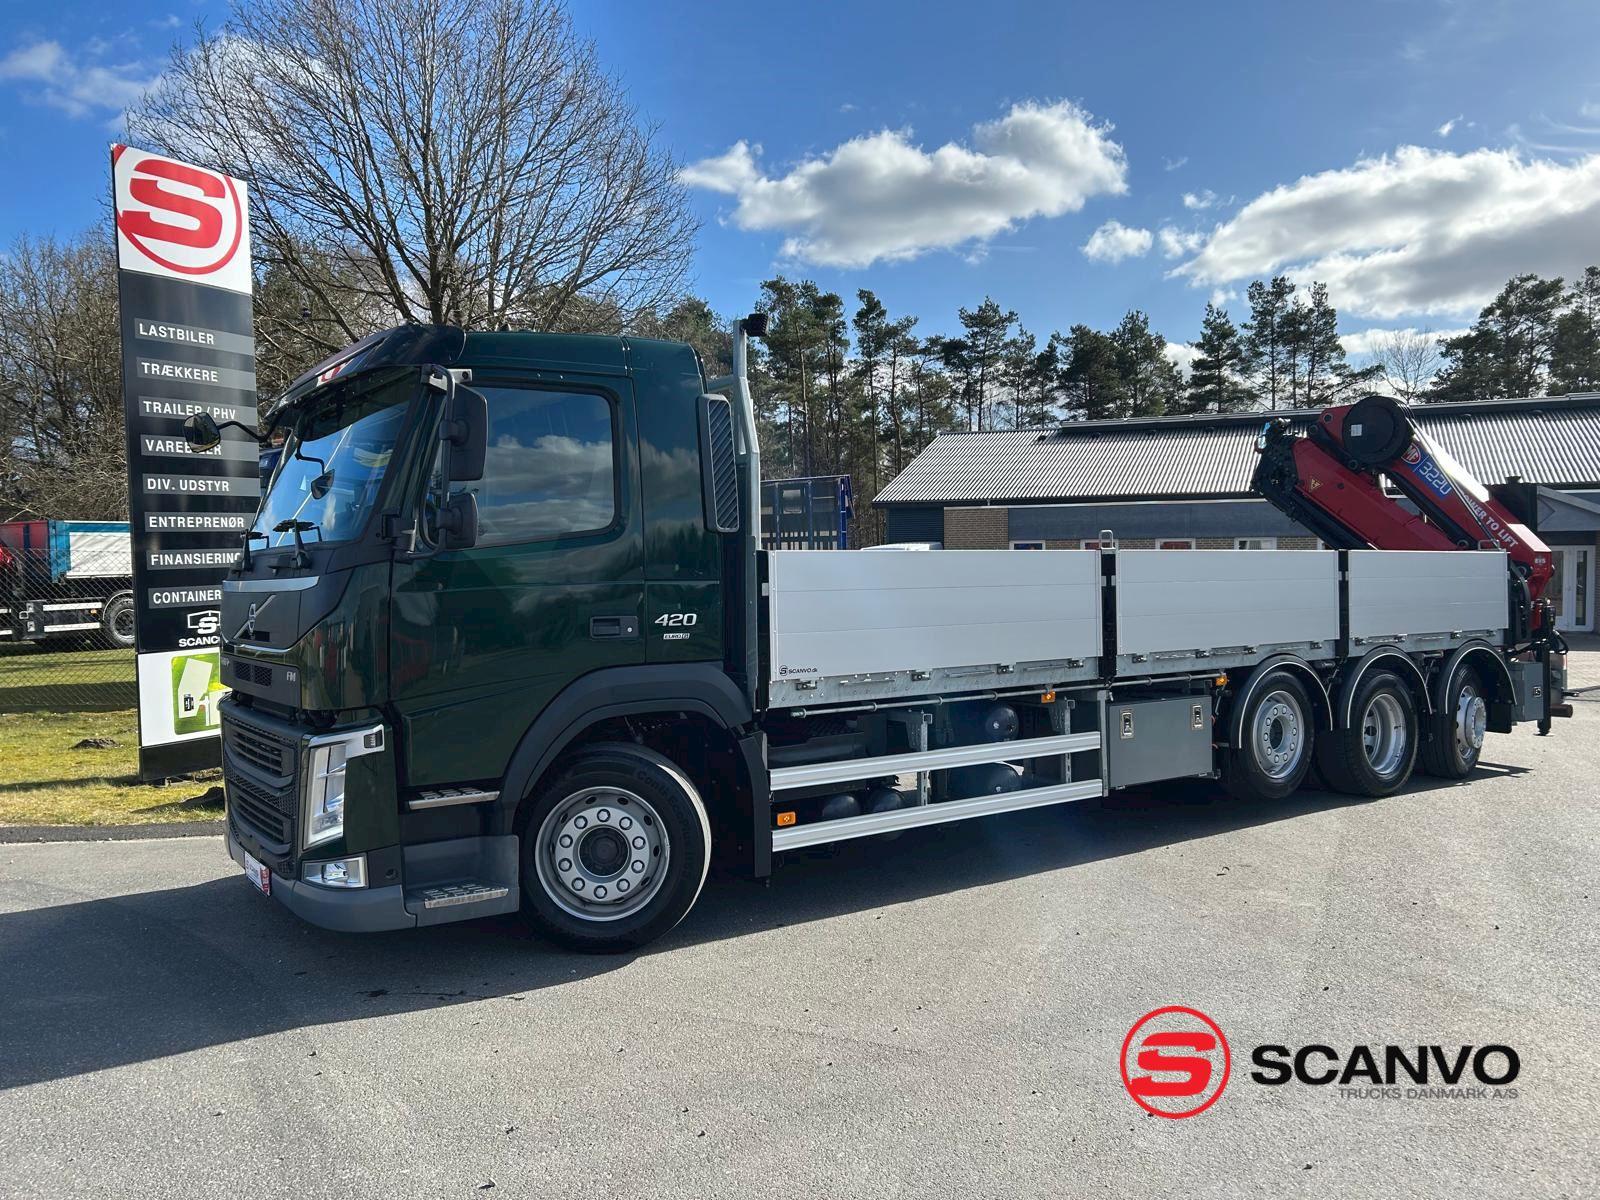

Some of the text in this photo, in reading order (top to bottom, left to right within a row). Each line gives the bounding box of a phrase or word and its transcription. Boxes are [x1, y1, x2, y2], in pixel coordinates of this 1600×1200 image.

[121, 158, 227, 249] S
[139, 323, 215, 345] LASTBILER
[142, 362, 219, 382] TRÆKKERE
[143, 401, 203, 416] TRAILER
[213, 407, 237, 420] PHV
[145, 439, 222, 456] VAREBR
[147, 478, 230, 492] DIV. UDSTYR
[149, 516, 245, 528] ENTREPRENØR
[1486, 516, 1500, 531] TO
[1497, 529, 1519, 548] LIFT
[153, 589, 222, 605] CONTAINER
[654, 613, 697, 626] 420
[178, 635, 221, 647] SCANC
